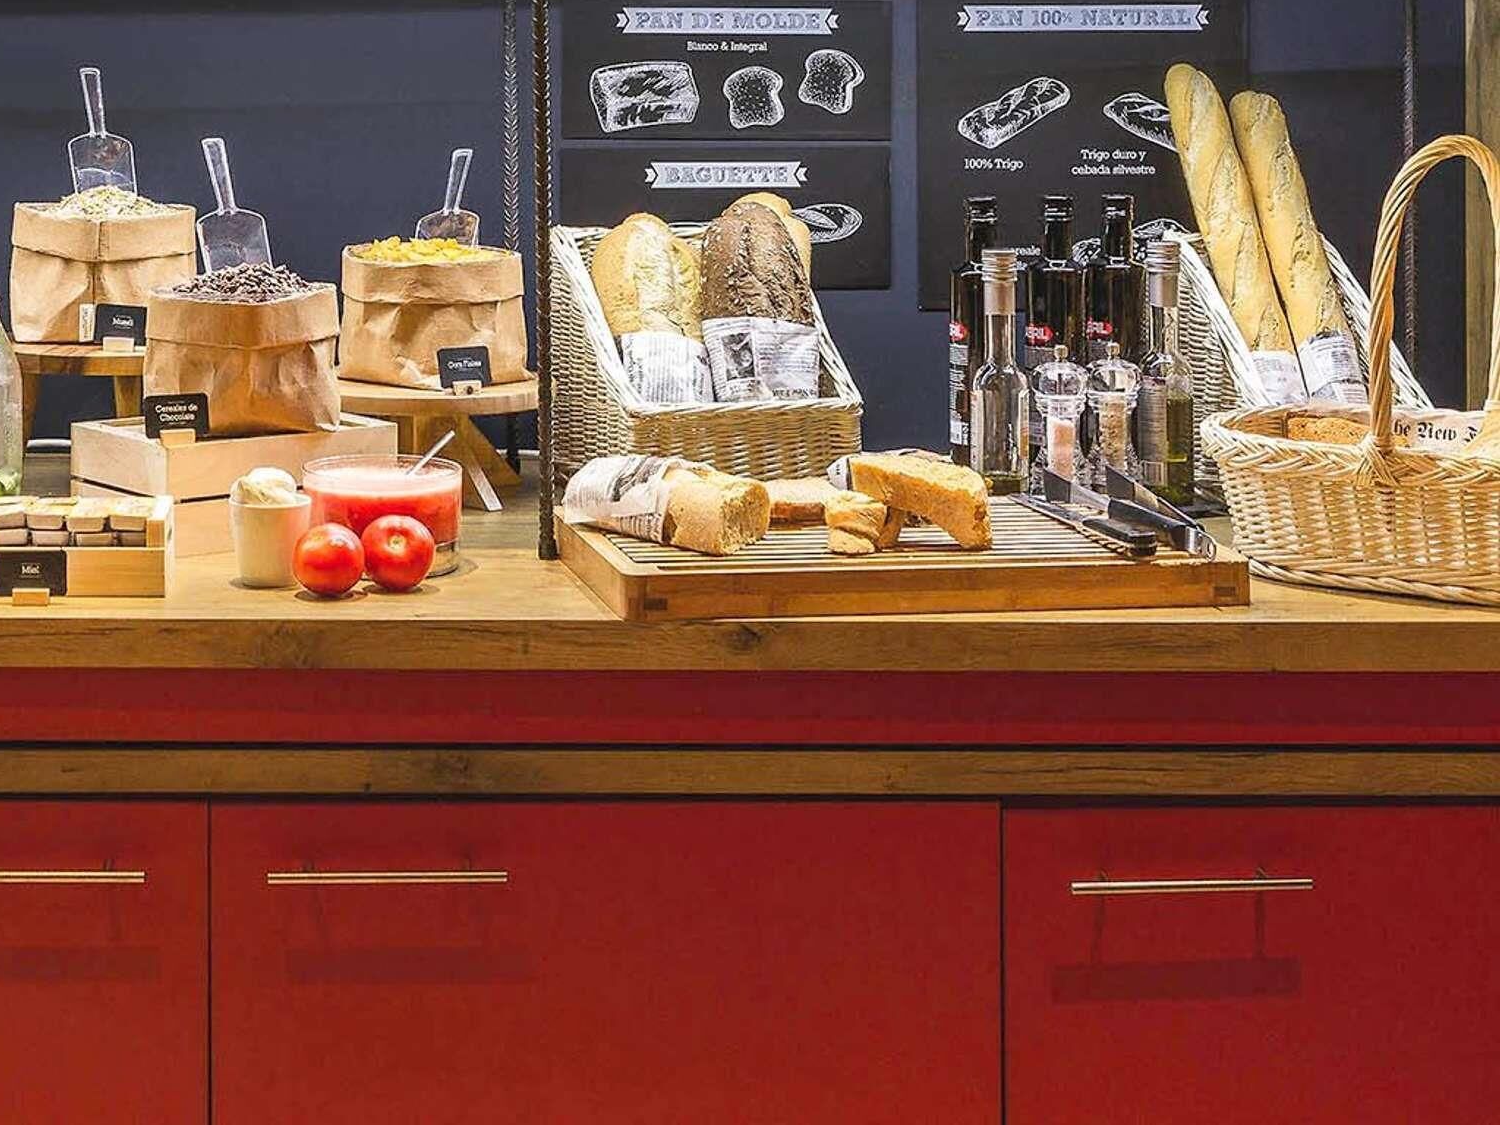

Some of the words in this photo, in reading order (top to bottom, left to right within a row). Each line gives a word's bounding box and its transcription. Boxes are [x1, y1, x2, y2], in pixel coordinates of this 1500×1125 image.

[635, 12, 684, 29] PAN
[691, 12, 724, 29] DE
[731, 11, 821, 30] MOLDE
[976, 10, 1024, 26] PAN
[1031, 10, 1073, 26] 100%
[1080, 9, 1192, 26] NATURAL
[686, 41, 719, 51] Blanco
[721, 41, 729, 51] &
[730, 41, 768, 53] Integral
[1080, 149, 1110, 162] Trigo
[1112, 149, 1137, 160] duro
[1139, 151, 1147, 161] y
[964, 158, 993, 170] 100%
[994, 158, 1024, 172] Trigo
[1112, 164, 1156, 175] silvestre
[664, 165, 789, 184] BAGUETTE
[1393, 419, 1409, 437] he
[1417, 421, 1457, 441] New
